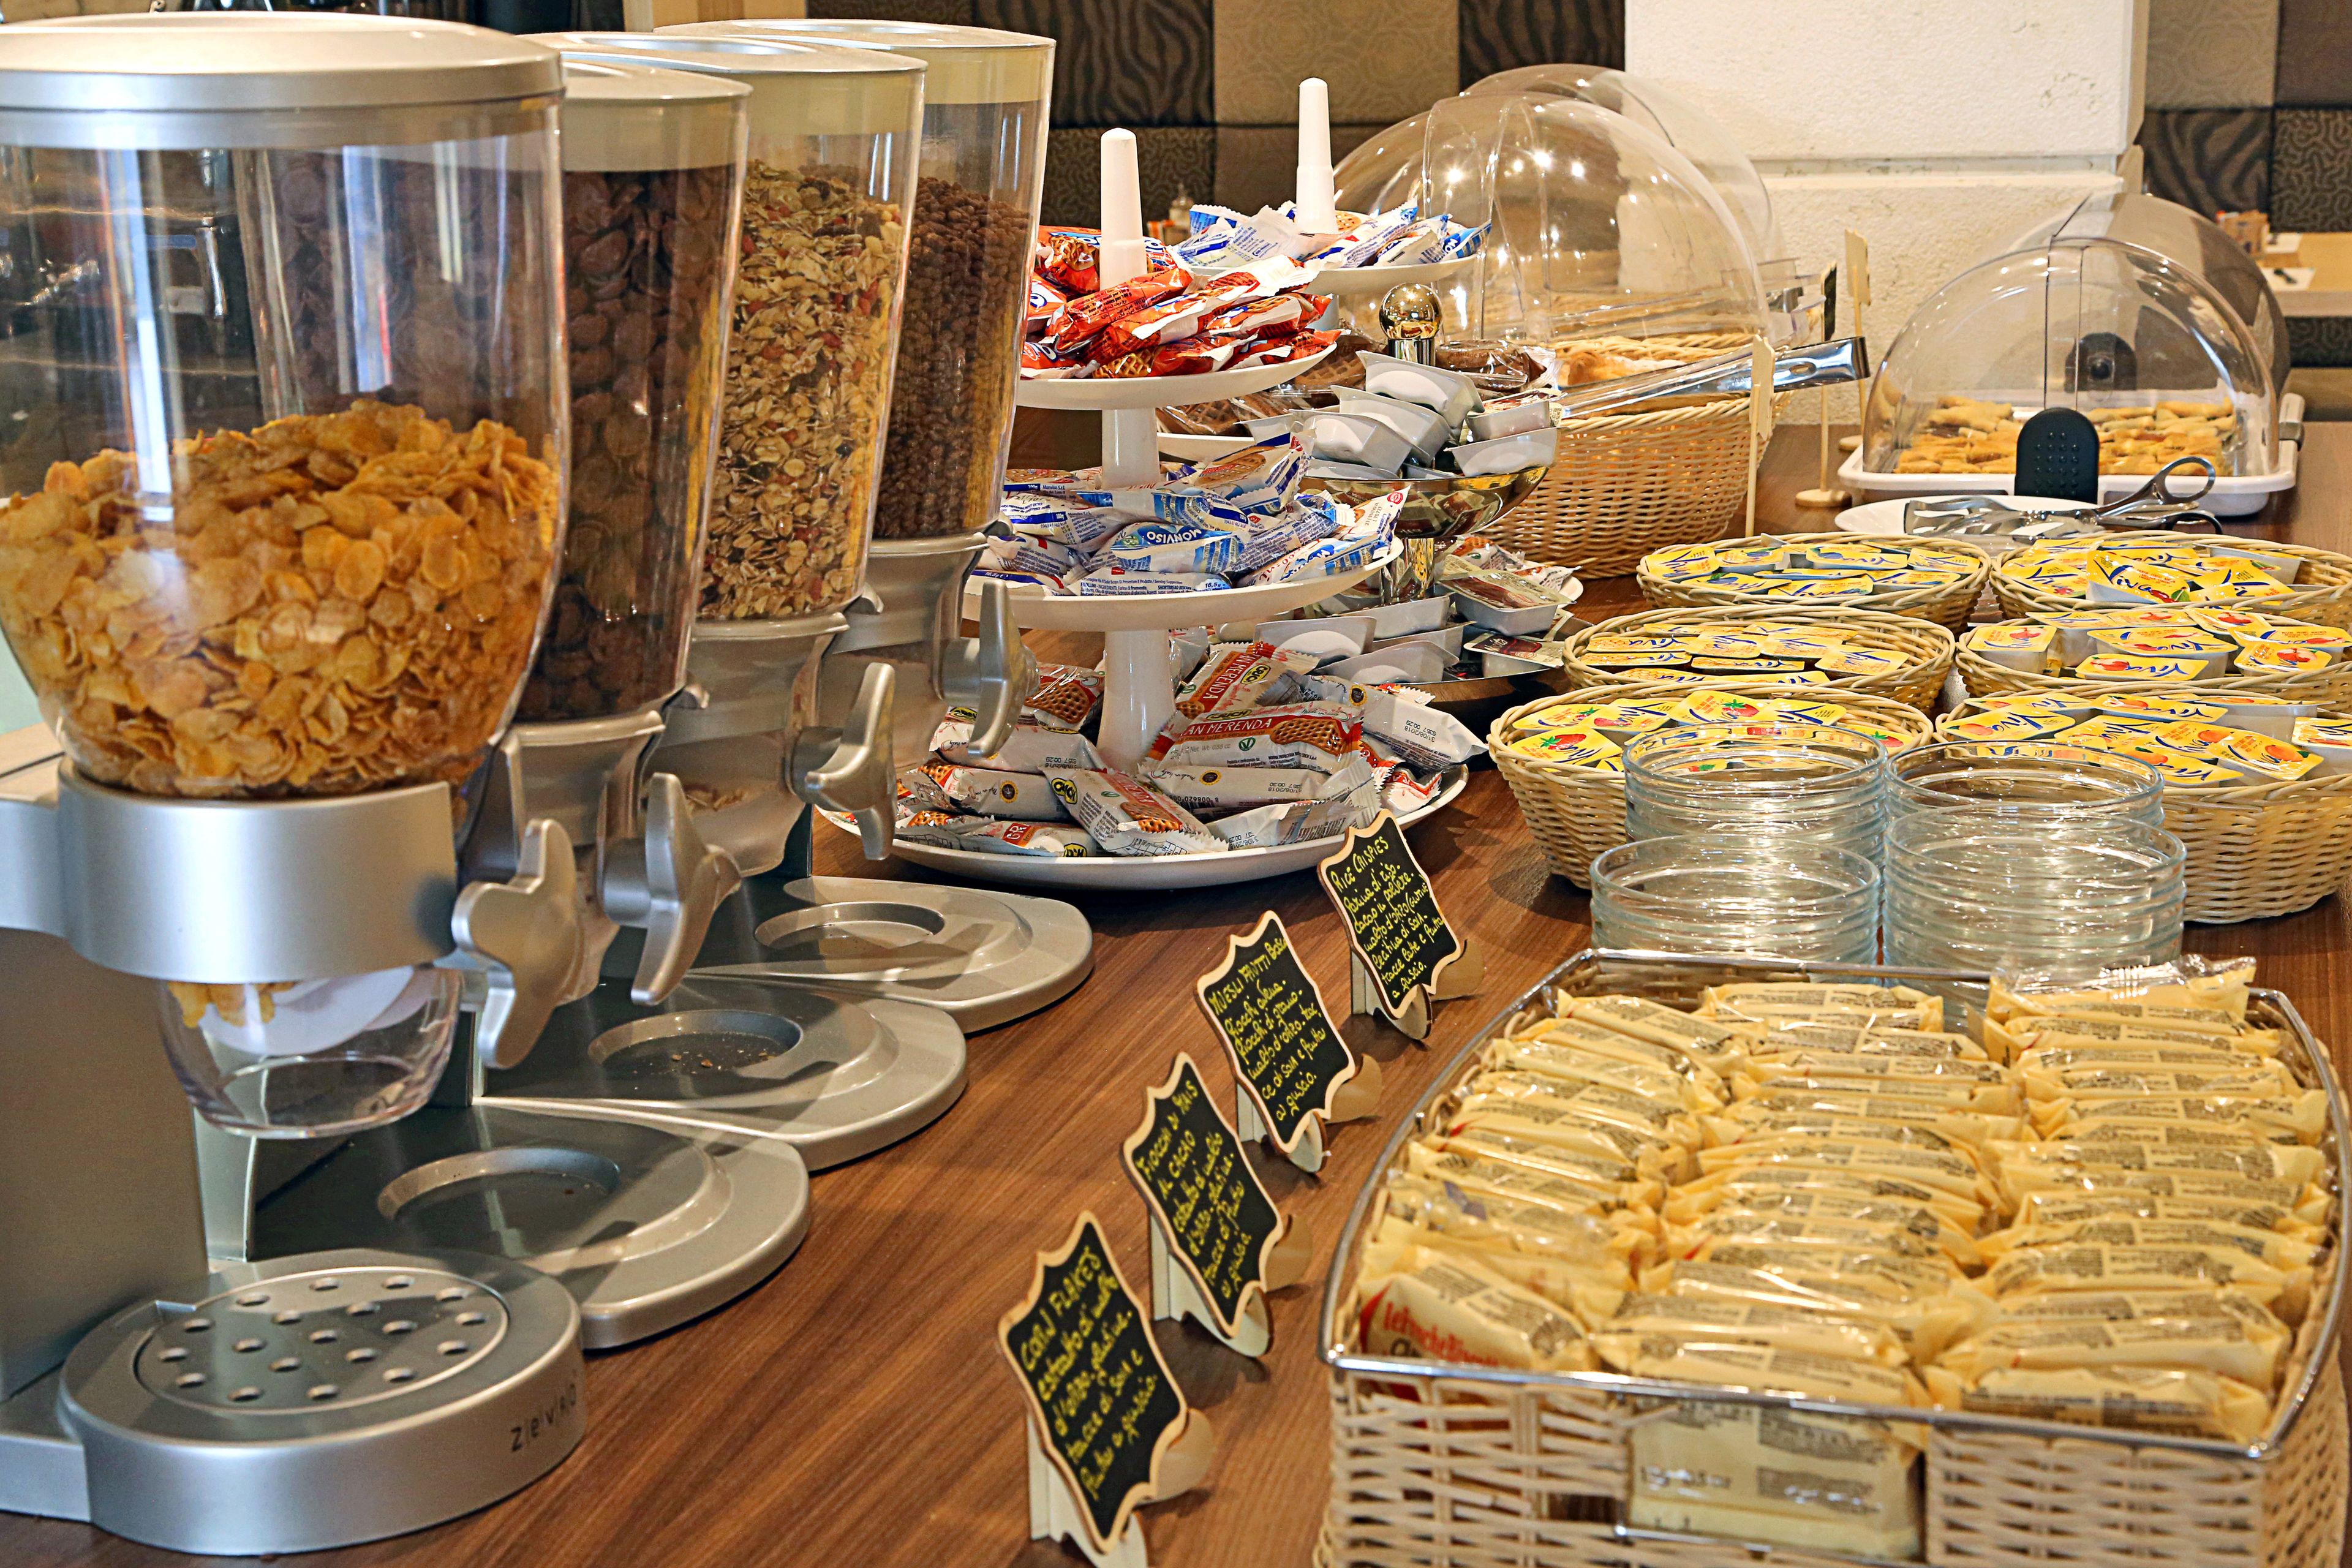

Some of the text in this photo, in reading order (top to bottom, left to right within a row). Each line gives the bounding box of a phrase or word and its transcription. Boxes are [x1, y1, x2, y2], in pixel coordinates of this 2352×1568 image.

[1147, 529, 1202, 545] MONVISO
[2092, 559, 2153, 592] Viva
[2156, 639, 2224, 651] Viva
[1203, 662, 1244, 699] MERENDA
[2126, 663, 2190, 677] Viva
[1206, 718, 1272, 734] MERENDA
[1403, 725, 1436, 742] 31/08/2018
[1991, 712, 2059, 732] Viva
[1330, 835, 1389, 892] RICE CRISPIES
[1208, 977, 1244, 1015] MUESLI
[1237, 954, 1270, 982] FRUTTI
[1168, 1130, 1195, 1178] CACAO
[1049, 1246, 1100, 1315] FLAKES
